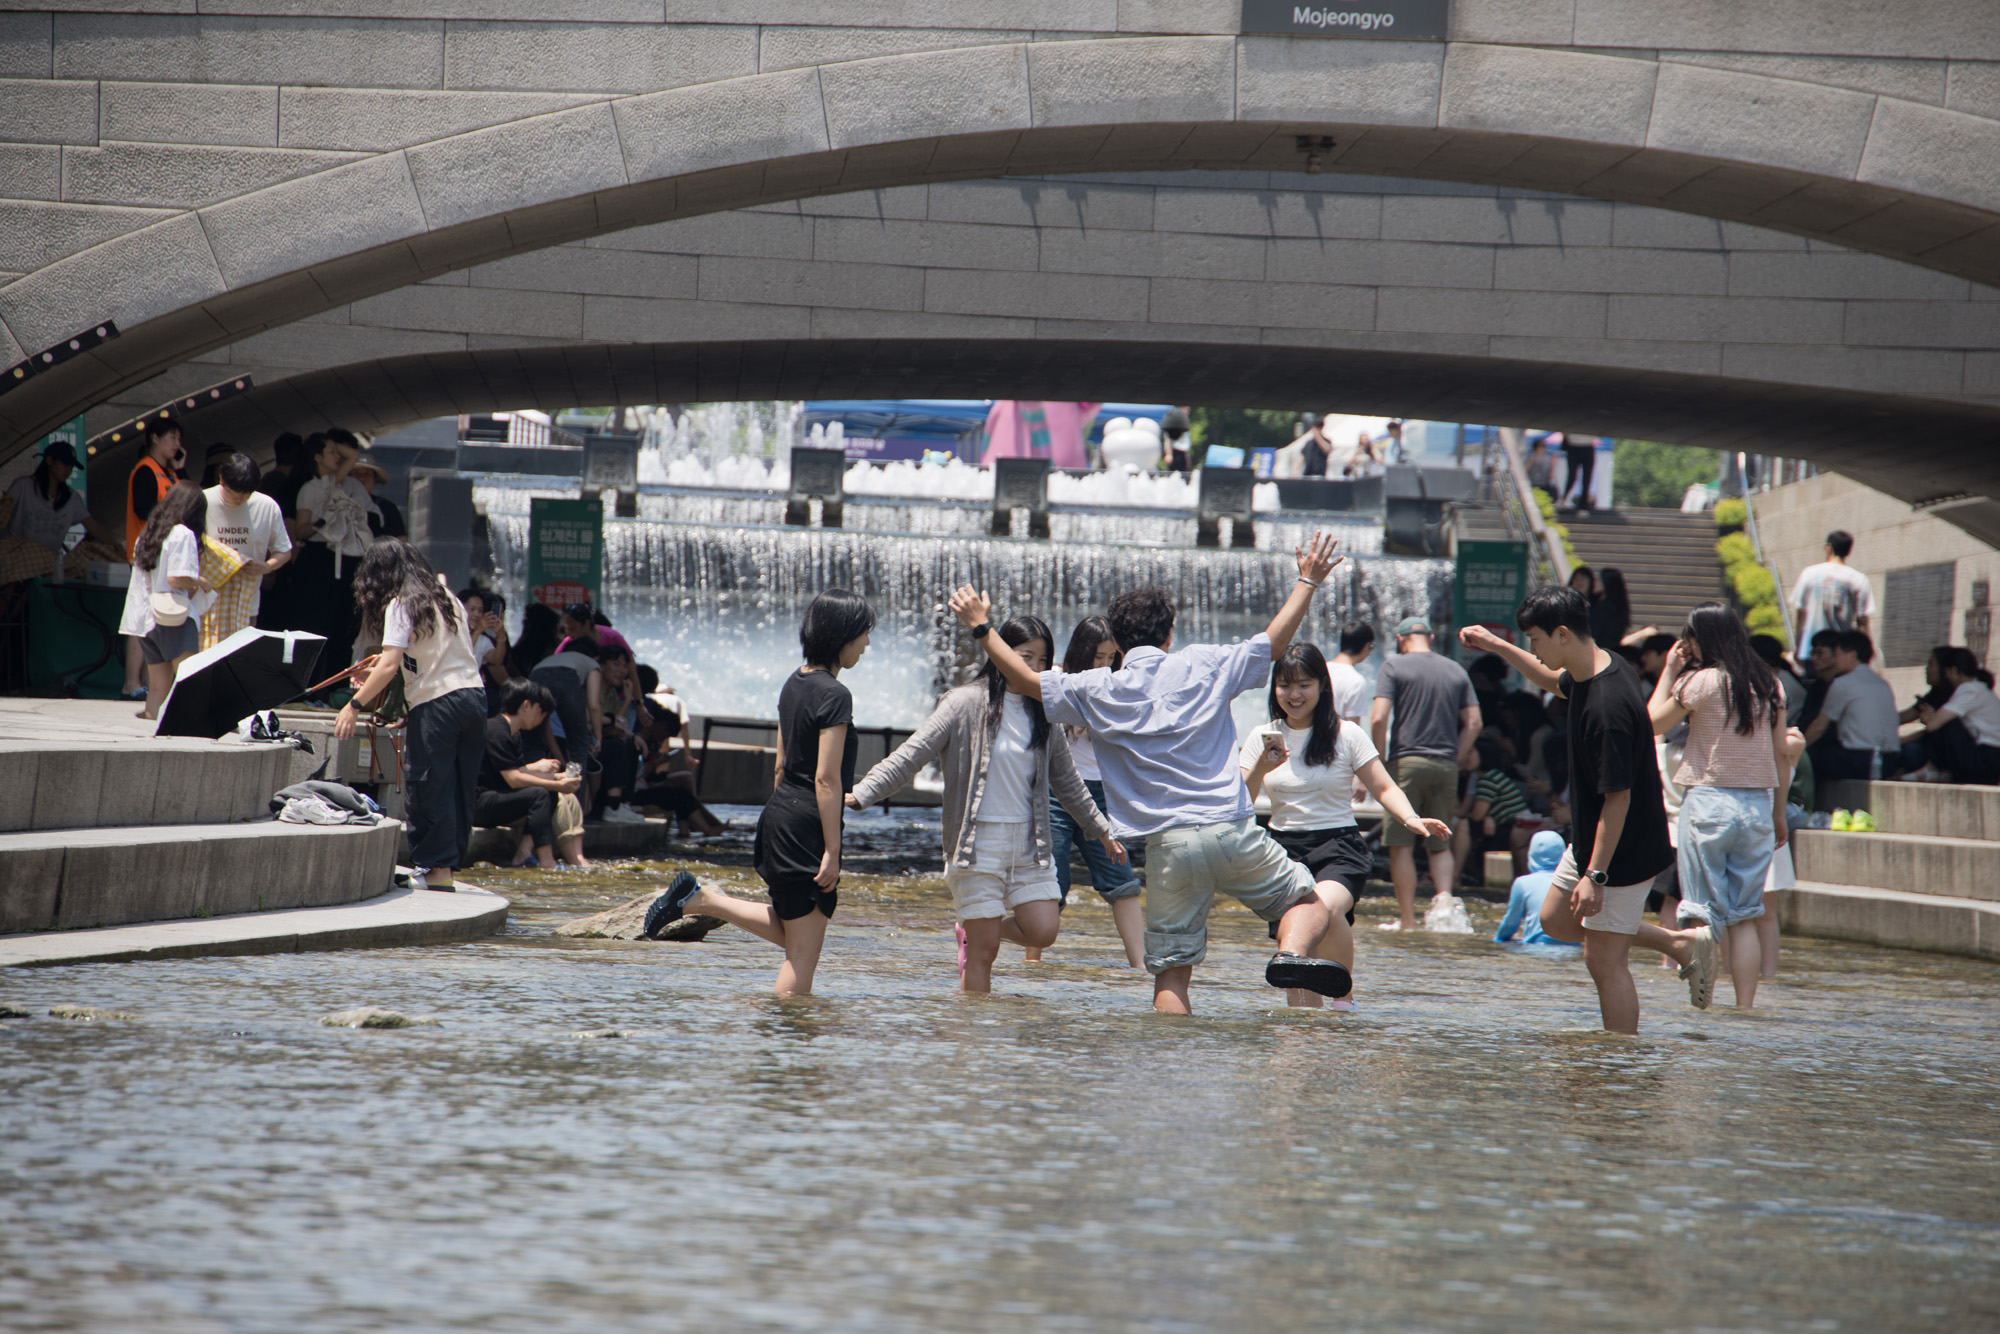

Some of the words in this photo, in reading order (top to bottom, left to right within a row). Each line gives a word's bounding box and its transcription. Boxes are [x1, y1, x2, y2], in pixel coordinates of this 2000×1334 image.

[1293, 6, 1395, 30] Mojeongyo
[217, 526, 250, 535] UNDER
[540, 528, 577, 543] 청계천
[218, 537, 248, 545] THINK
